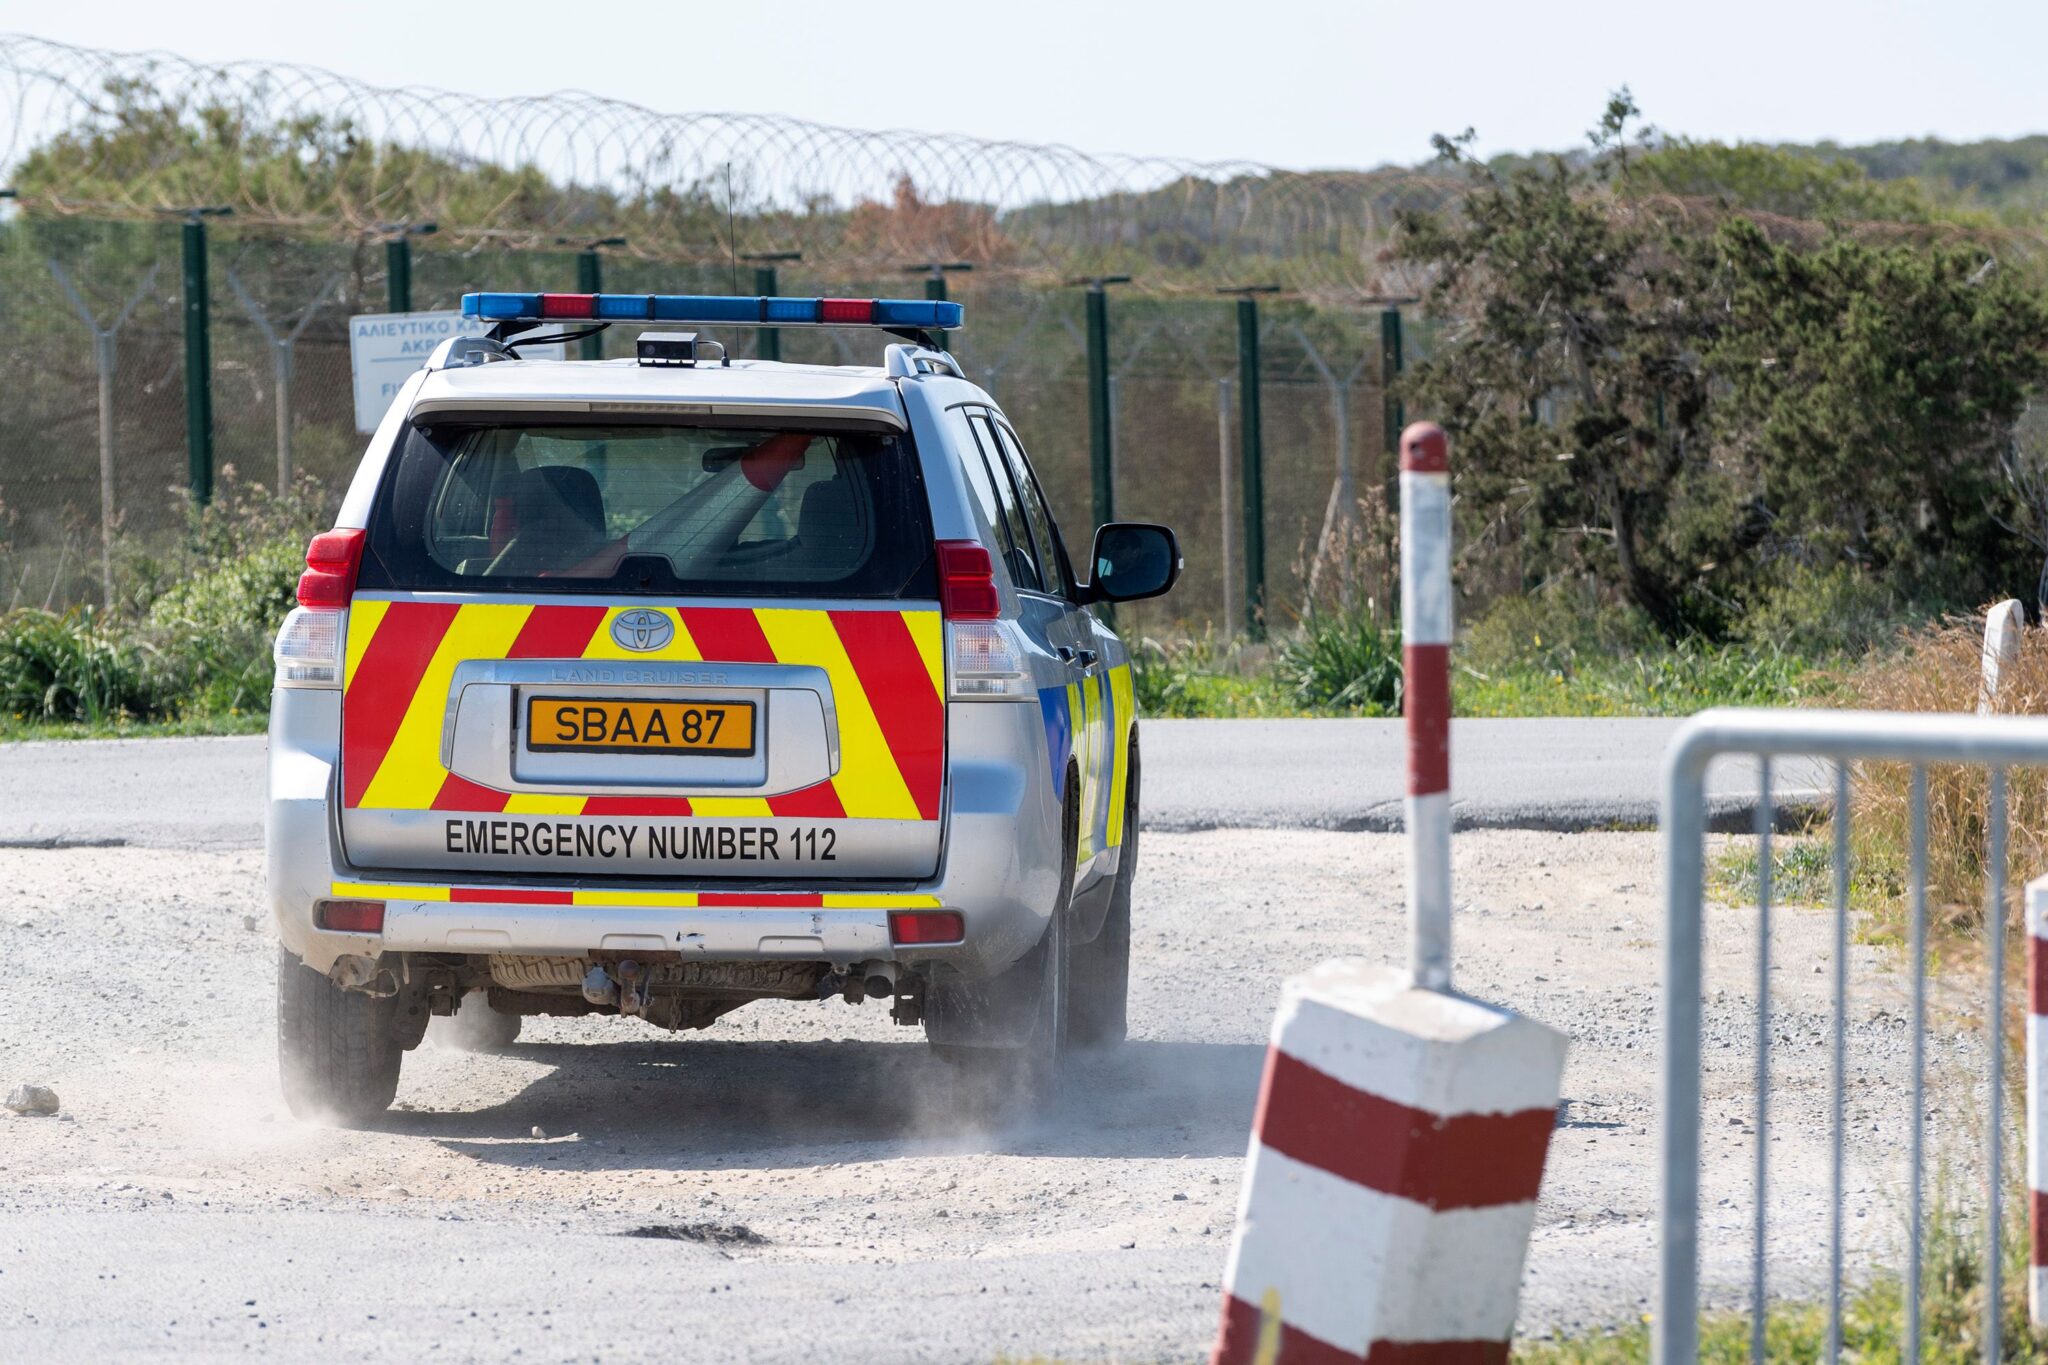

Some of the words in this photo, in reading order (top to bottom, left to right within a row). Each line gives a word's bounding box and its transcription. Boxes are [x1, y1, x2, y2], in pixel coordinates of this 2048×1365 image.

[401, 339, 442, 353] ΑΚΡ
[551, 669, 615, 683] LAND
[623, 671, 729, 684] CRUISER
[556, 707, 671, 743] SBAA
[682, 709, 726, 744] 87
[446, 820, 638, 858] EMERGENCY
[649, 825, 779, 861] NUMBER
[790, 827, 837, 861] 112
